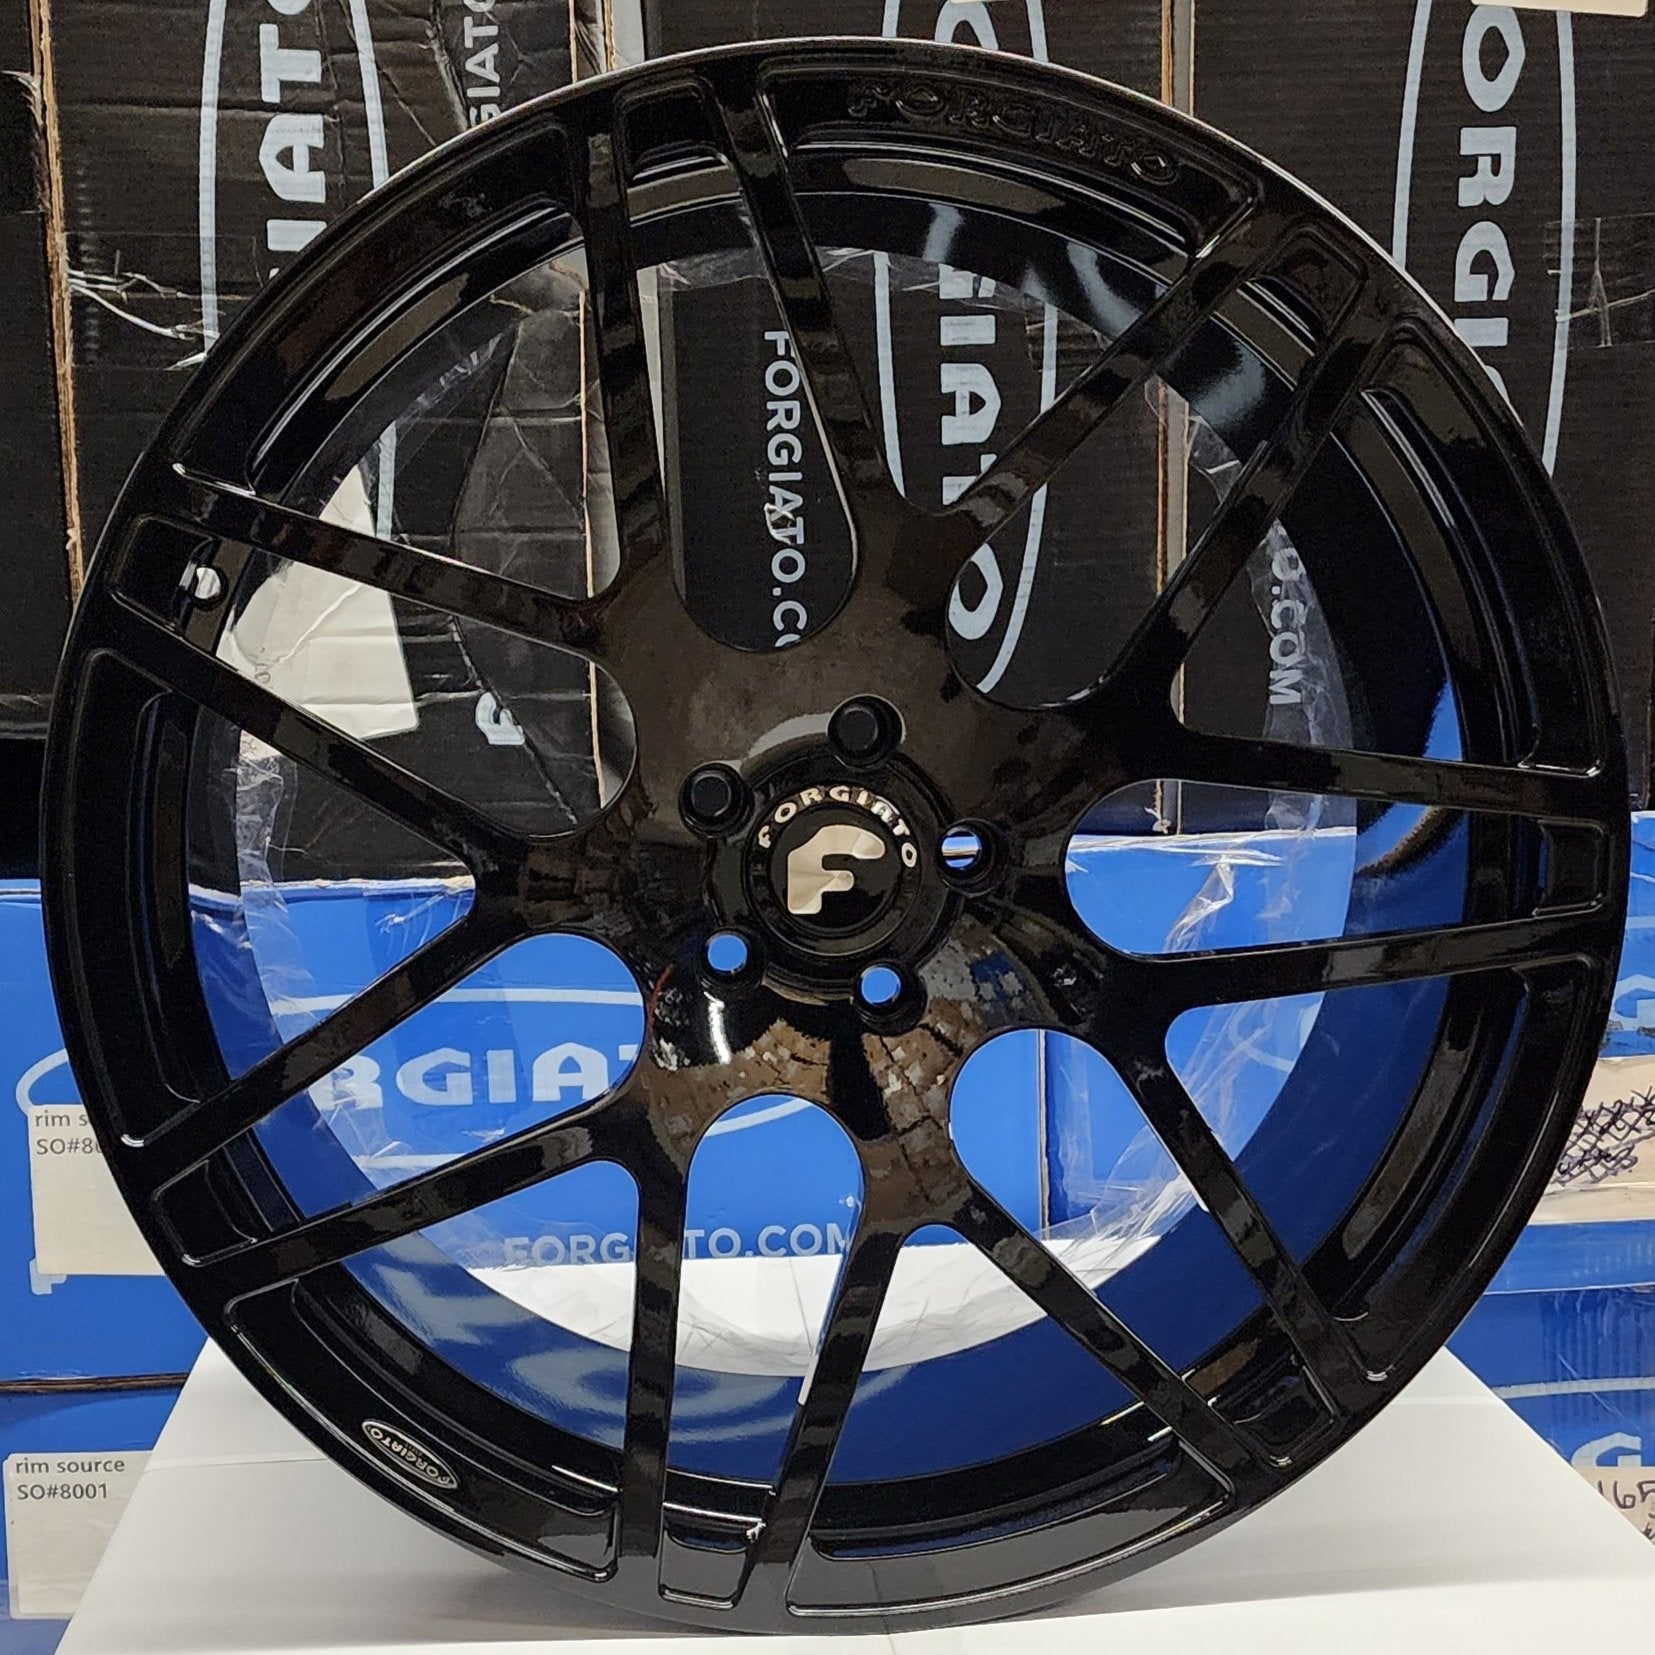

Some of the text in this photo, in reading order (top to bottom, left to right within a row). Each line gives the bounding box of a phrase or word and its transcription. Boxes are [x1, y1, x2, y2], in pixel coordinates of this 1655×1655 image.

[1454, 5, 1526, 427] ORGI
[758, 785, 918, 868] FORGIATO
[34, 1110, 71, 1127] rim
[15, 1457, 126, 1473] rim source
[369, 1428, 451, 1484] FORGIATO
[17, 1483, 108, 1500] SO#8001
